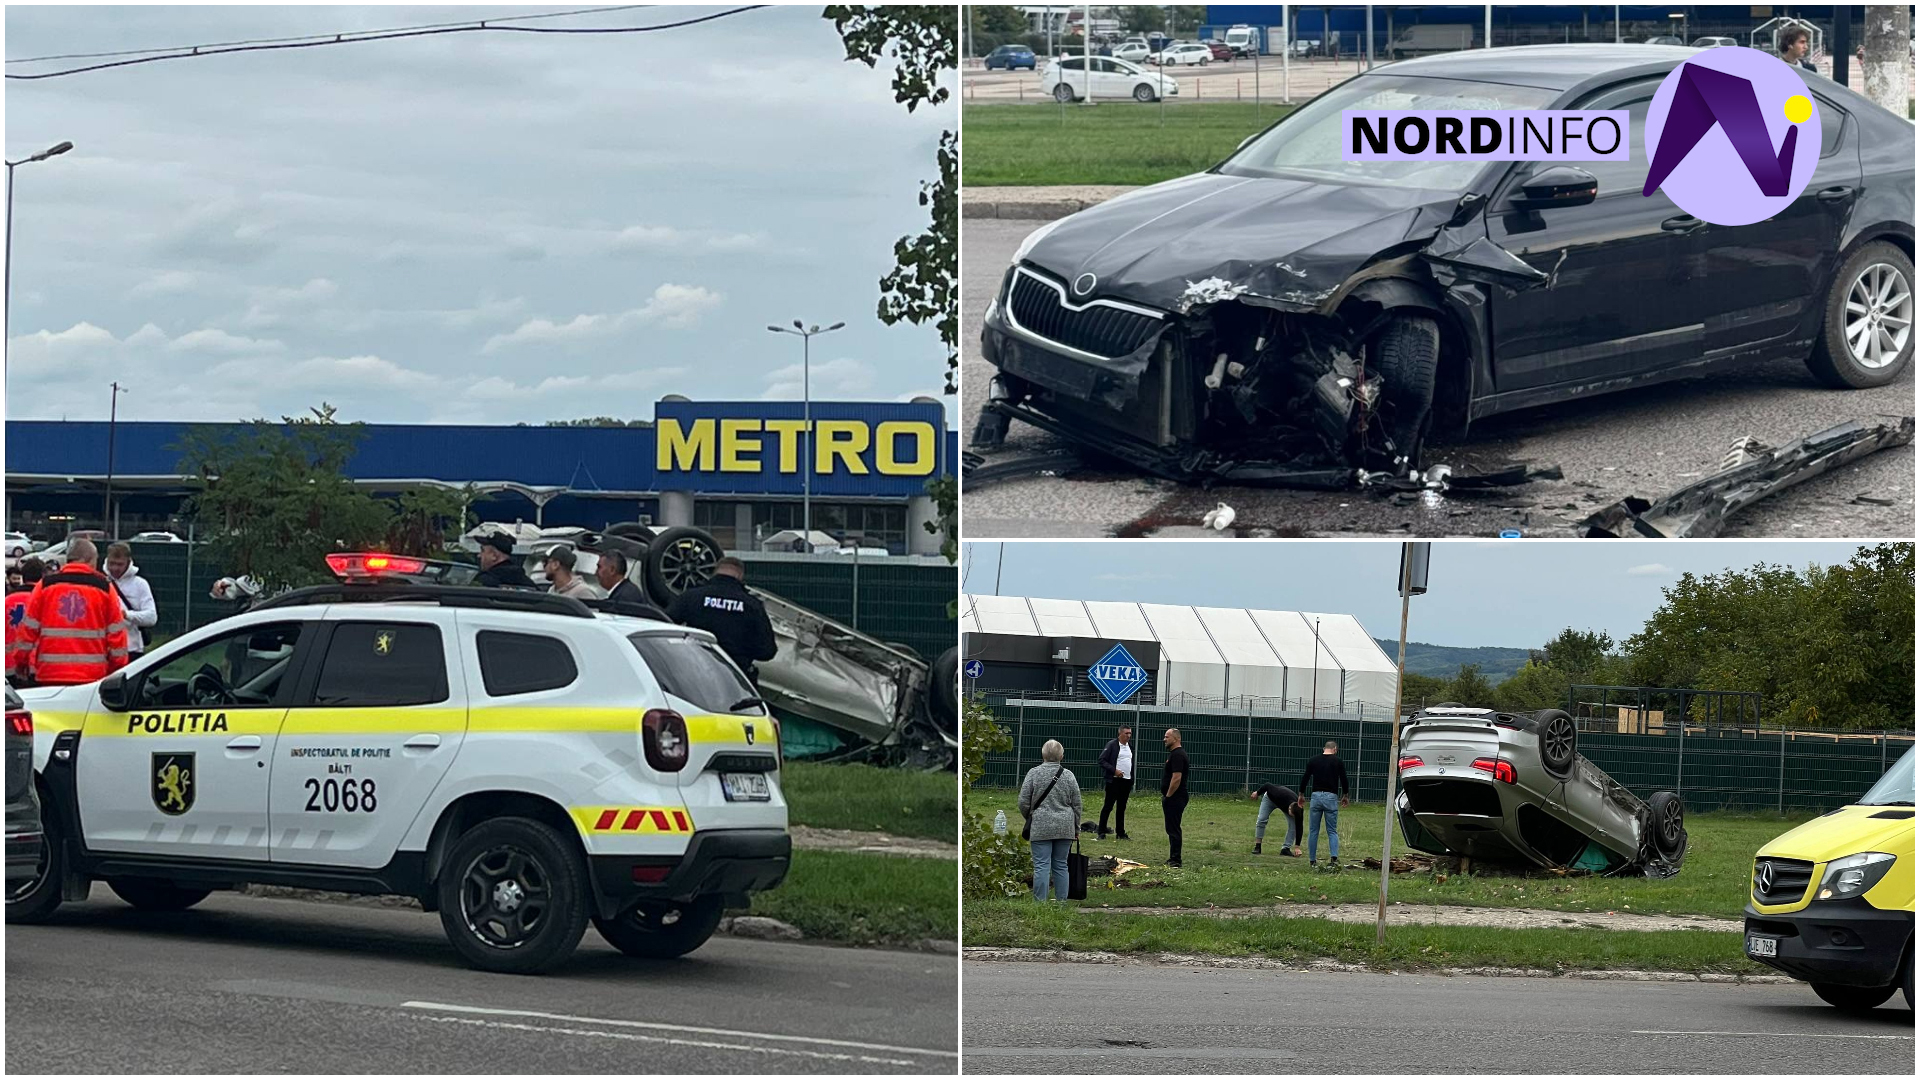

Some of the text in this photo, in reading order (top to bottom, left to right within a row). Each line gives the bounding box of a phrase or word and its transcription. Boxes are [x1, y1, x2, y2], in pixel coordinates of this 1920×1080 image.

[656, 418, 935, 475] METRO
[1098, 665, 1138, 681] VEKA
[127, 713, 228, 734] POLIȚIA
[290, 748, 348, 758] INSPECTORATUL
[351, 748, 361, 758] DE
[304, 778, 377, 812] 2068
